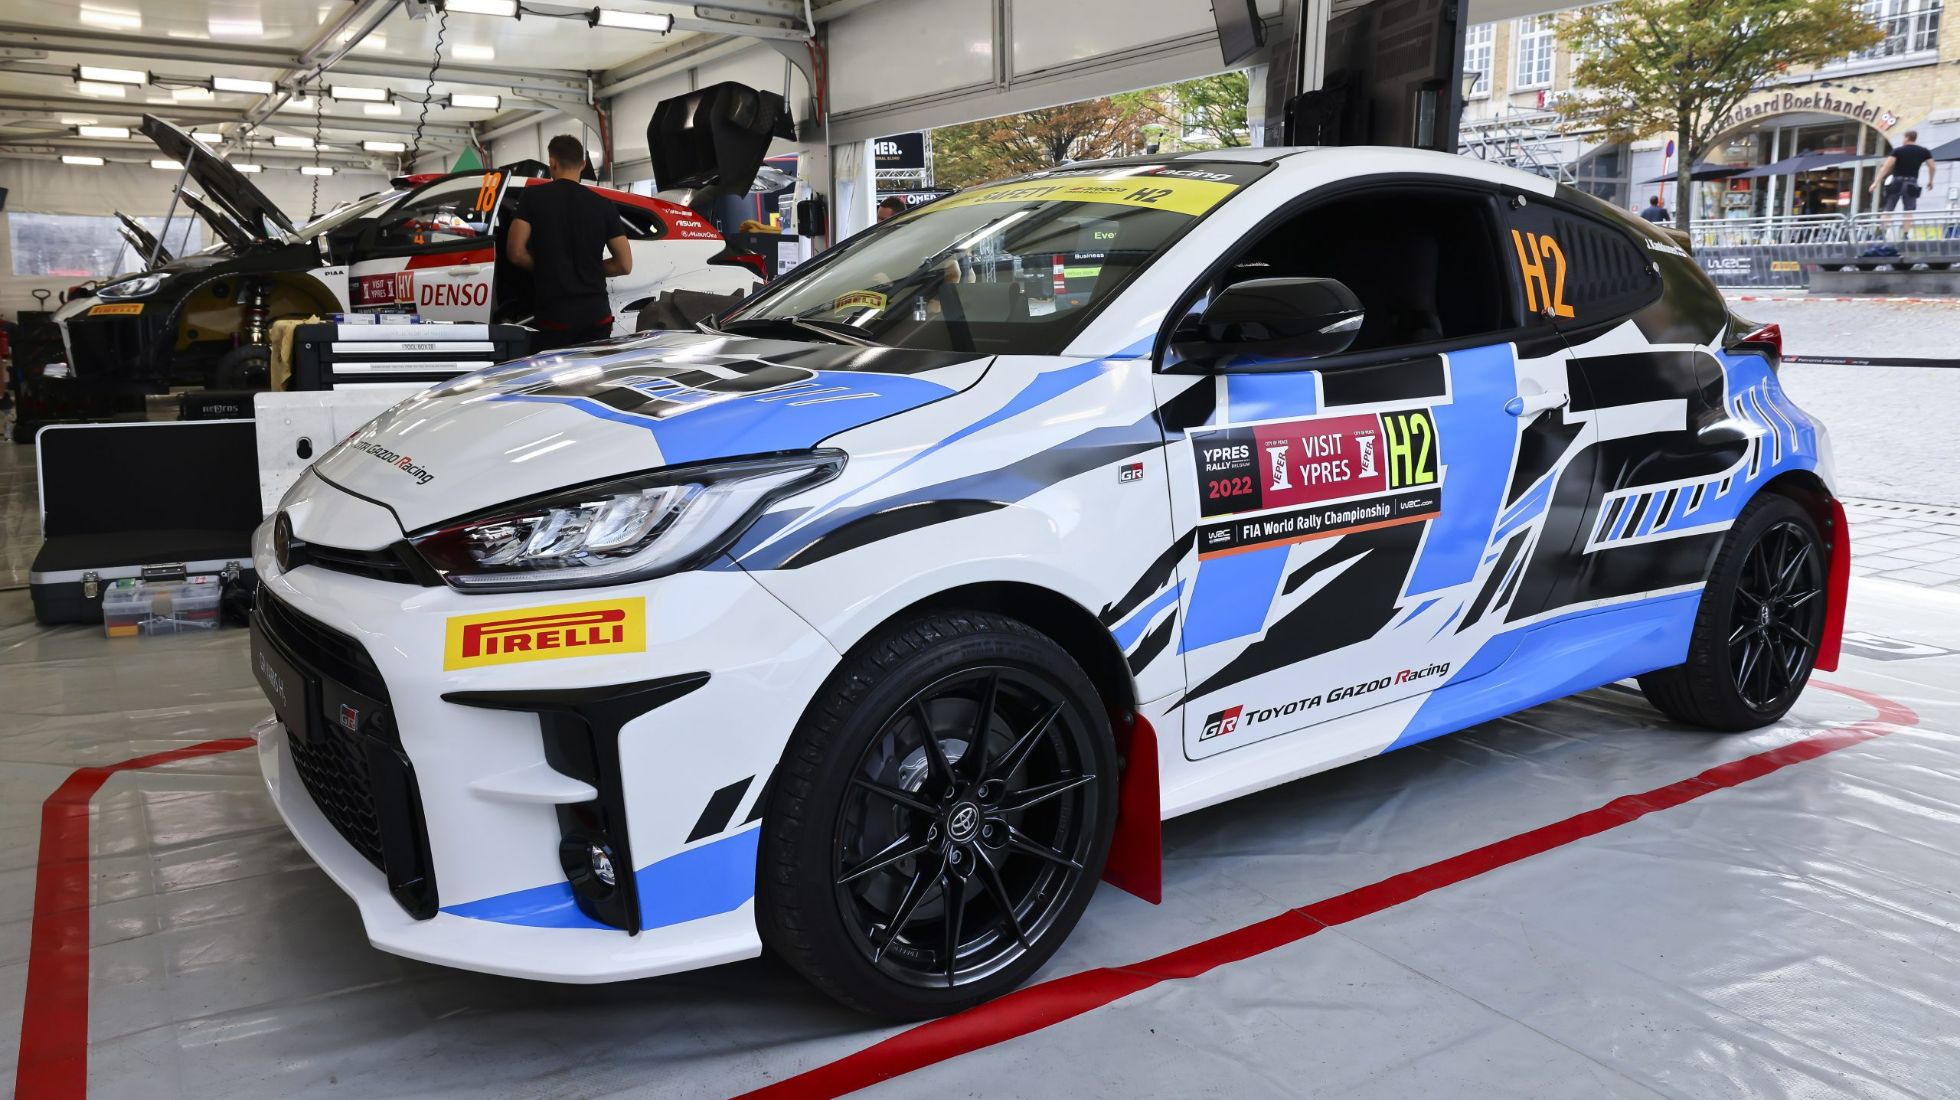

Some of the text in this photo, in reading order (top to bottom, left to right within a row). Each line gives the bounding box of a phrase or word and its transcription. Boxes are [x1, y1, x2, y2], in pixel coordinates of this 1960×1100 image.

[1783, 92, 1880, 122] Boekhandel
[476, 172, 502, 212] 18
[1123, 187, 1174, 203] H2
[1511, 229, 1576, 318] H2
[1708, 258, 1751, 269] WRC
[372, 279, 385, 289] VISIT
[398, 274, 412, 299] HY
[420, 283, 488, 307] DENSO
[1203, 445, 1250, 462] YPRES
[1302, 433, 1343, 458] VISIT
[1383, 413, 1434, 487] H2
[366, 444, 401, 463] GAZOO
[394, 456, 435, 486] Racing
[1121, 469, 1143, 481] GR
[1206, 461, 1231, 472] RALLY
[1300, 459, 1351, 486] YPRES
[1208, 476, 1253, 499] 2022
[1208, 529, 1231, 538] WRC
[1243, 504, 1391, 540] FIA World Rally Championship
[462, 609, 626, 658] PIRELLI
[1245, 662, 1450, 726] TOYOTA GAZOO Racing
[1201, 717, 1239, 740] GR
